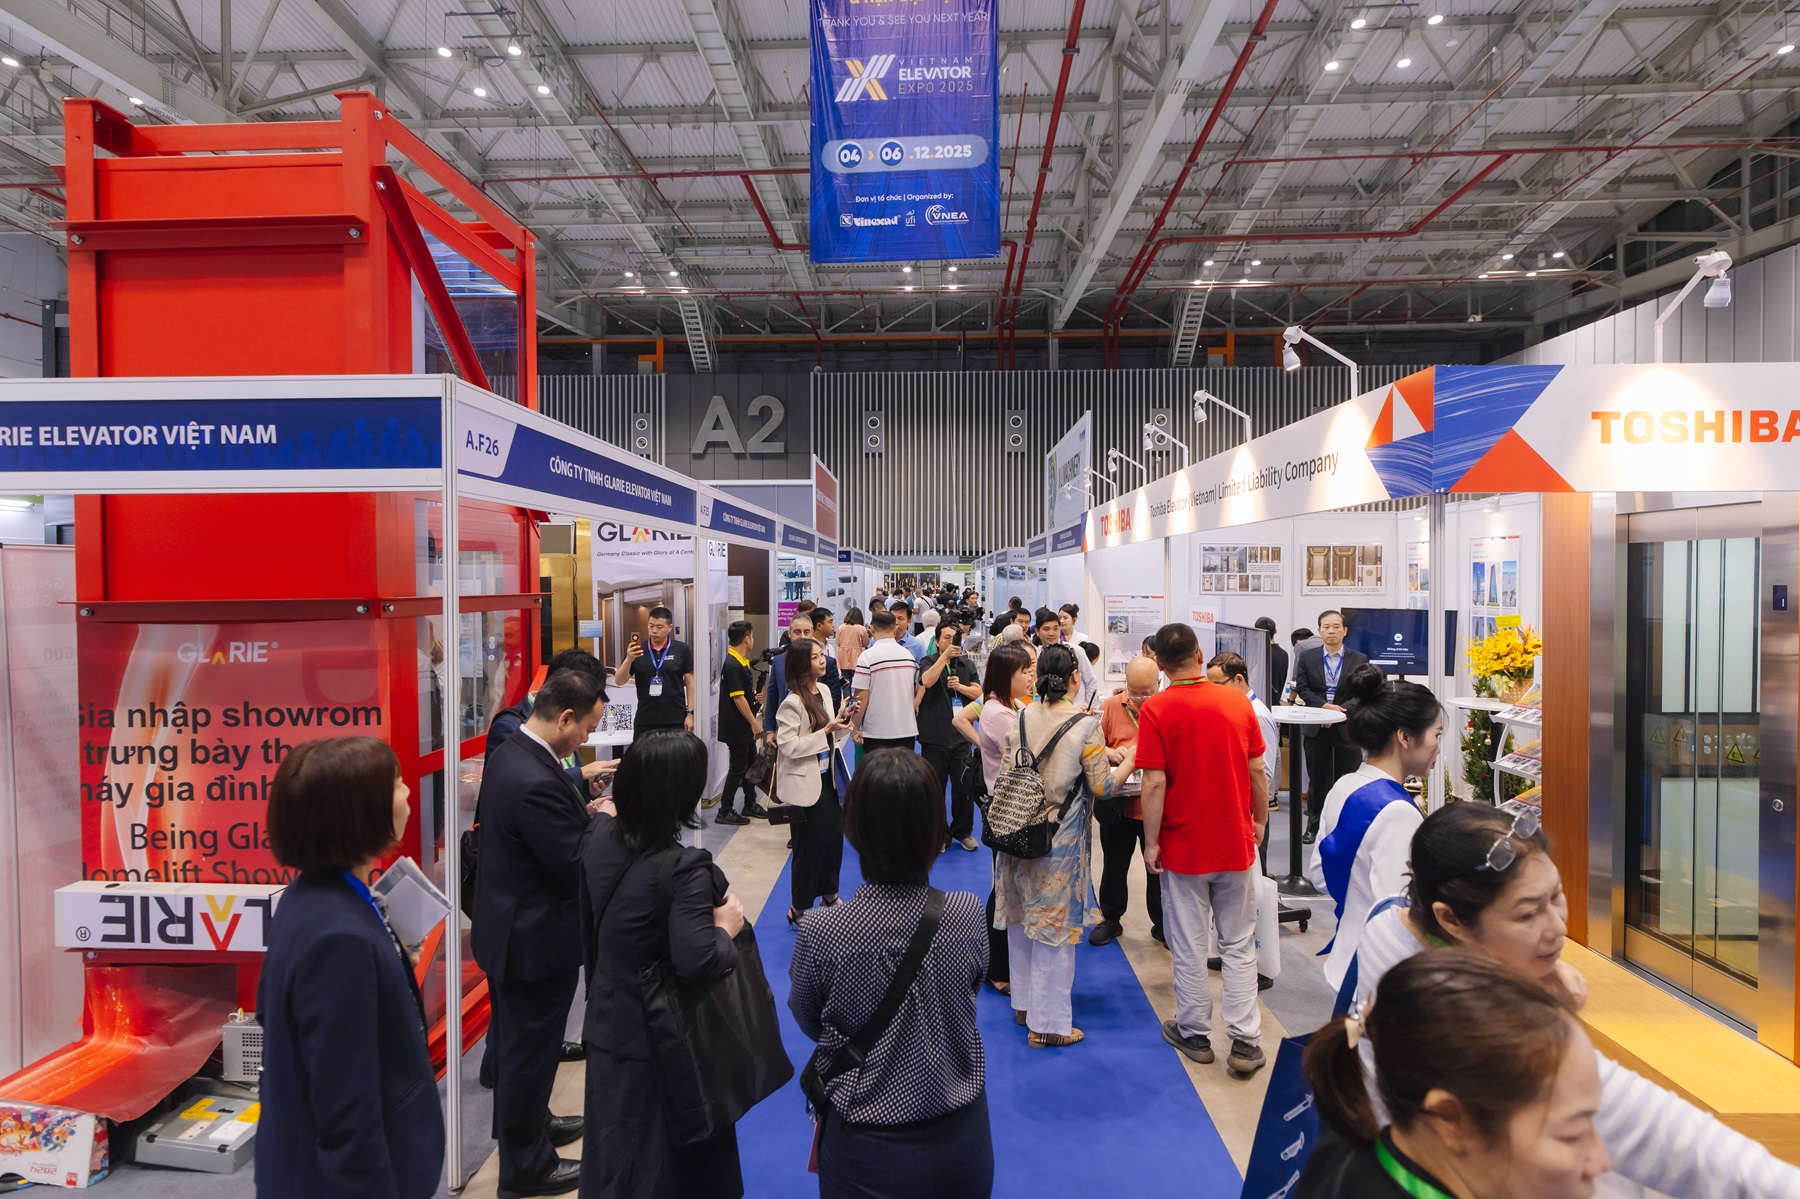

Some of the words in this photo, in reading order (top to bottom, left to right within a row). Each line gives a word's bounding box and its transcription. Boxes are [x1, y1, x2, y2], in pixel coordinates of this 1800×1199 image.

[818, 17, 850, 28] THANK
[853, 16, 875, 27] YOU
[878, 16, 885, 25] &
[888, 16, 905, 25] SEE
[908, 14, 930, 24] YOU
[933, 12, 958, 23] NEXT
[961, 10, 990, 22] YEAR!
[898, 56, 973, 66] VIETNAM
[898, 66, 972, 81] ELEVATOR
[898, 82, 934, 94] EXPO
[939, 80, 973, 93] 2025
[840, 149, 861, 163] 04
[881, 147, 902, 161] 06
[907, 193, 942, 201] Organized
[943, 193, 953, 201] by:
[932, 212, 968, 220] VNEA
[39, 425, 158, 446] ELEVATOR
[161, 421, 214, 450] VIỆT
[220, 424, 277, 445] NAM
[691, 395, 786, 454] A2
[465, 430, 499, 457] A.F26
[549, 455, 573, 480] CÔNG
[573, 464, 584, 481] TY
[584, 467, 603, 487] TNHH
[604, 474, 625, 493] GLARIE
[625, 481, 651, 500] ELEVATOR
[651, 488, 661, 505] VIỆT
[661, 495, 672, 506] NAM
[1100, 507, 1131, 537] TOSHIBA
[1150, 501, 1166, 518] Toshiba
[1167, 496, 1187, 515] Elevator
[1189, 484, 1217, 511] (Vietnam)
[1218, 475, 1246, 500] Limited
[1247, 467, 1283, 492] Liability
[1285, 451, 1339, 482] Company
[1192, 610, 1214, 624] TOSHIBA
[79, 702, 115, 728] ia
[128, 702, 210, 734] nhập
[222, 701, 381, 728] showrom
[84, 740, 179, 772] trưng
[191, 738, 251, 771] bày
[80, 776, 134, 809] áy
[145, 775, 195, 809] gia
[130, 822, 218, 857] Being
[82, 859, 203, 882] omelift
